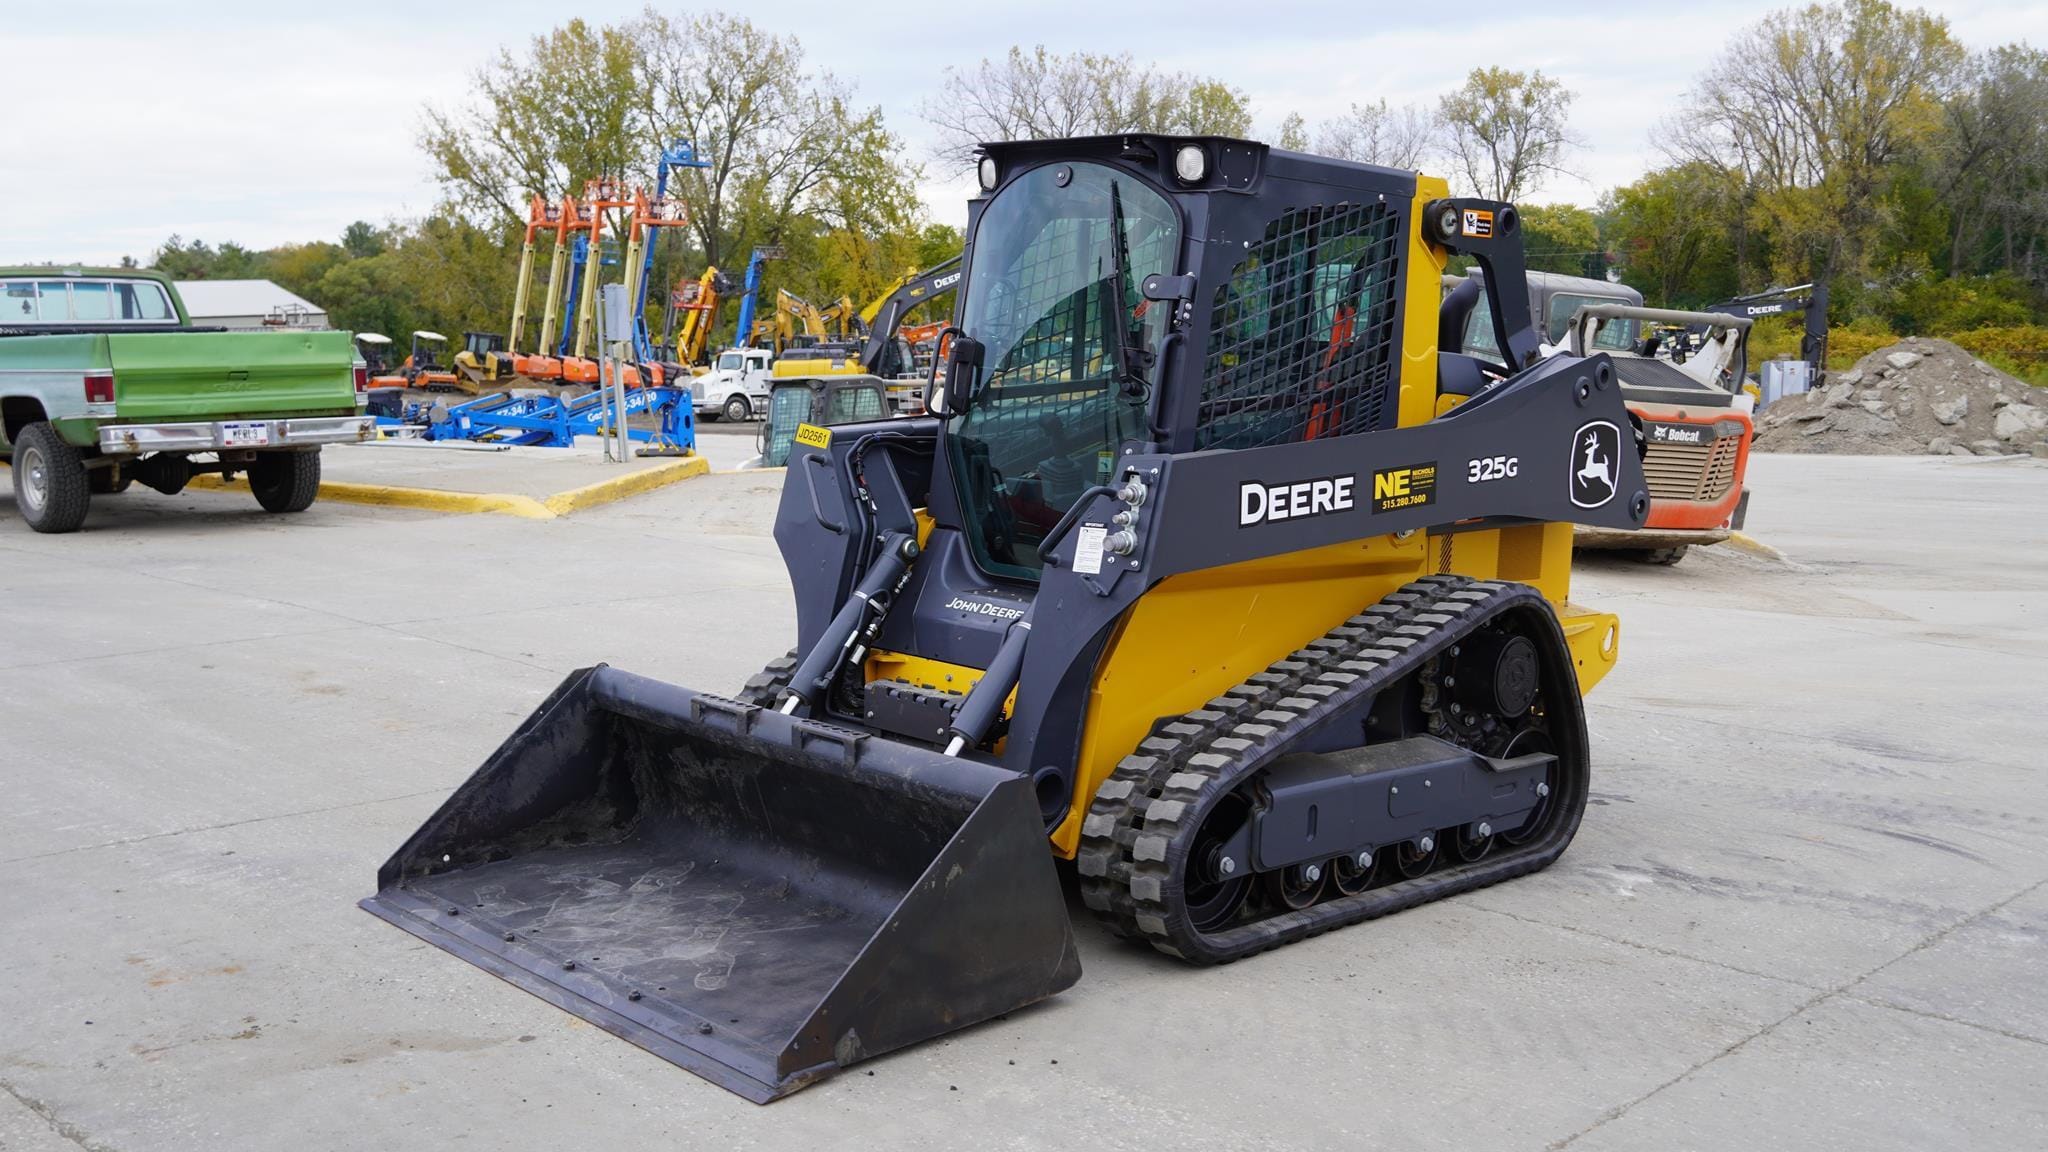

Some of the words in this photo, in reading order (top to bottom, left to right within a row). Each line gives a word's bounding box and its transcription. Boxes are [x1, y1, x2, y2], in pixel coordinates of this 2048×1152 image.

[934, 273, 961, 289] DEER
[1747, 304, 1782, 315] DEERE
[798, 428, 827, 444] JD2561
[1668, 428, 1700, 442] Bobcat
[1468, 456, 1518, 483] 325G
[1375, 469, 1411, 500] NE
[1240, 476, 1354, 525] DEERE
[1382, 494, 1427, 509] 515.280.7600
[945, 597, 981, 613] JOHN
